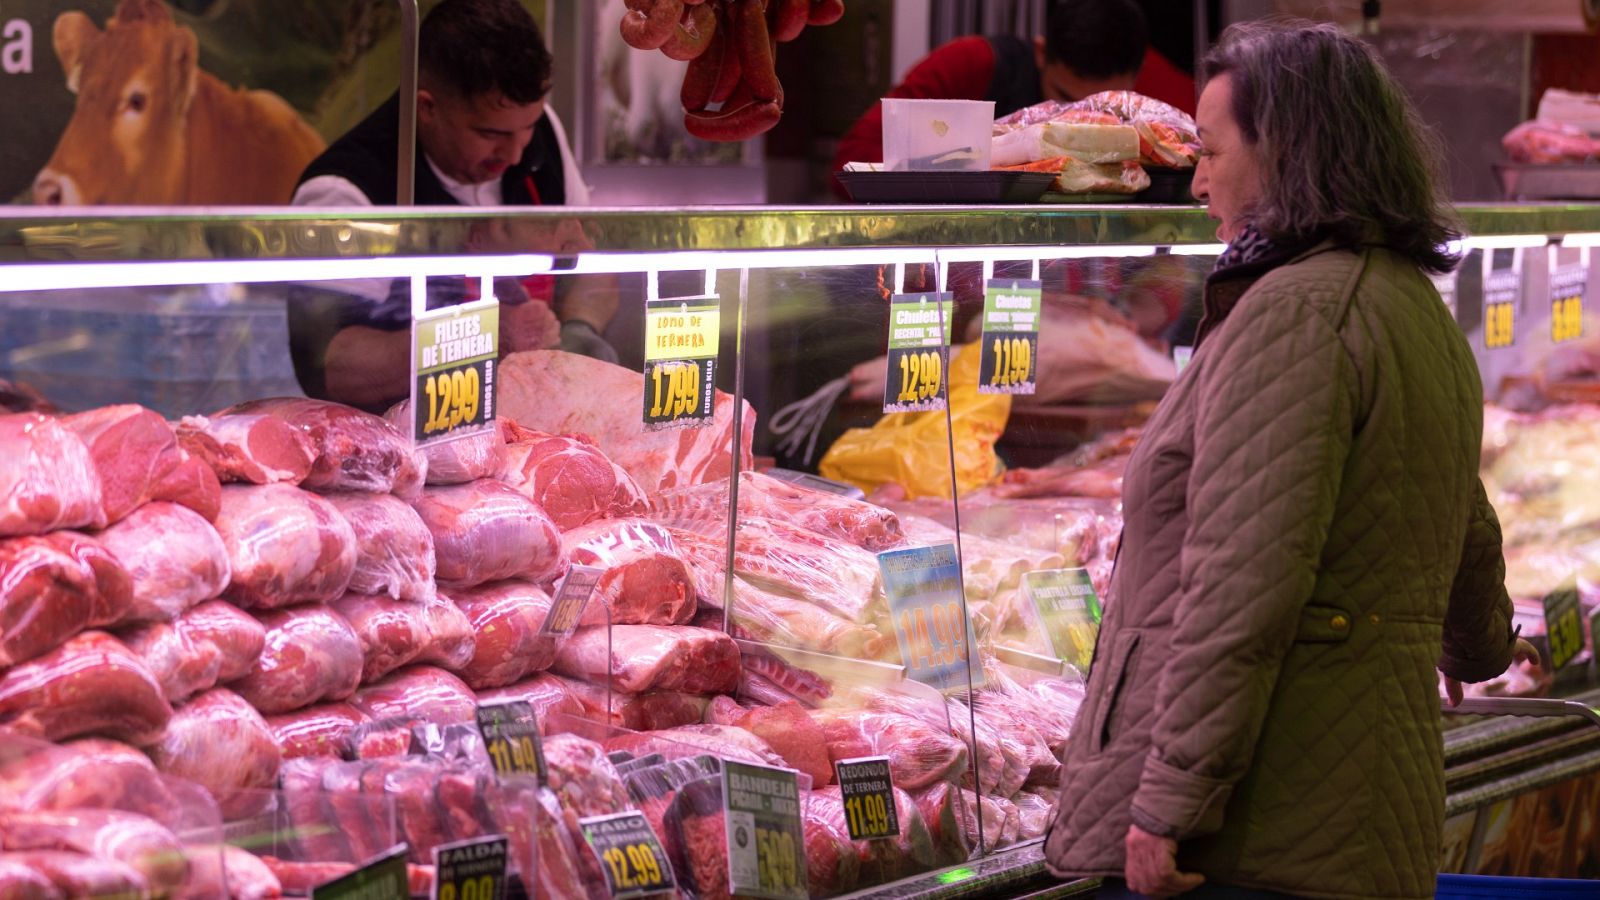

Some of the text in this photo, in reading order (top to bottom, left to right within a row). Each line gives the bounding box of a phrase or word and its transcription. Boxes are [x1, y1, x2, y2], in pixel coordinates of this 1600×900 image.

[434, 314, 481, 345] FILETES
[657, 315, 703, 328] LOMO DE
[422, 332, 494, 368] DE TERNERA
[656, 333, 705, 349] TERNERA
[483, 359, 493, 419] EUROS KILO
[703, 360, 713, 414] EUROS KILO
[840, 763, 886, 779] REDONDO
[730, 773, 796, 800] BANDEJA
[843, 780, 888, 794] DE TERNERA
[846, 794, 889, 836] 11.99
[441, 841, 505, 863] FALDA
[603, 843, 661, 889] 12.99
